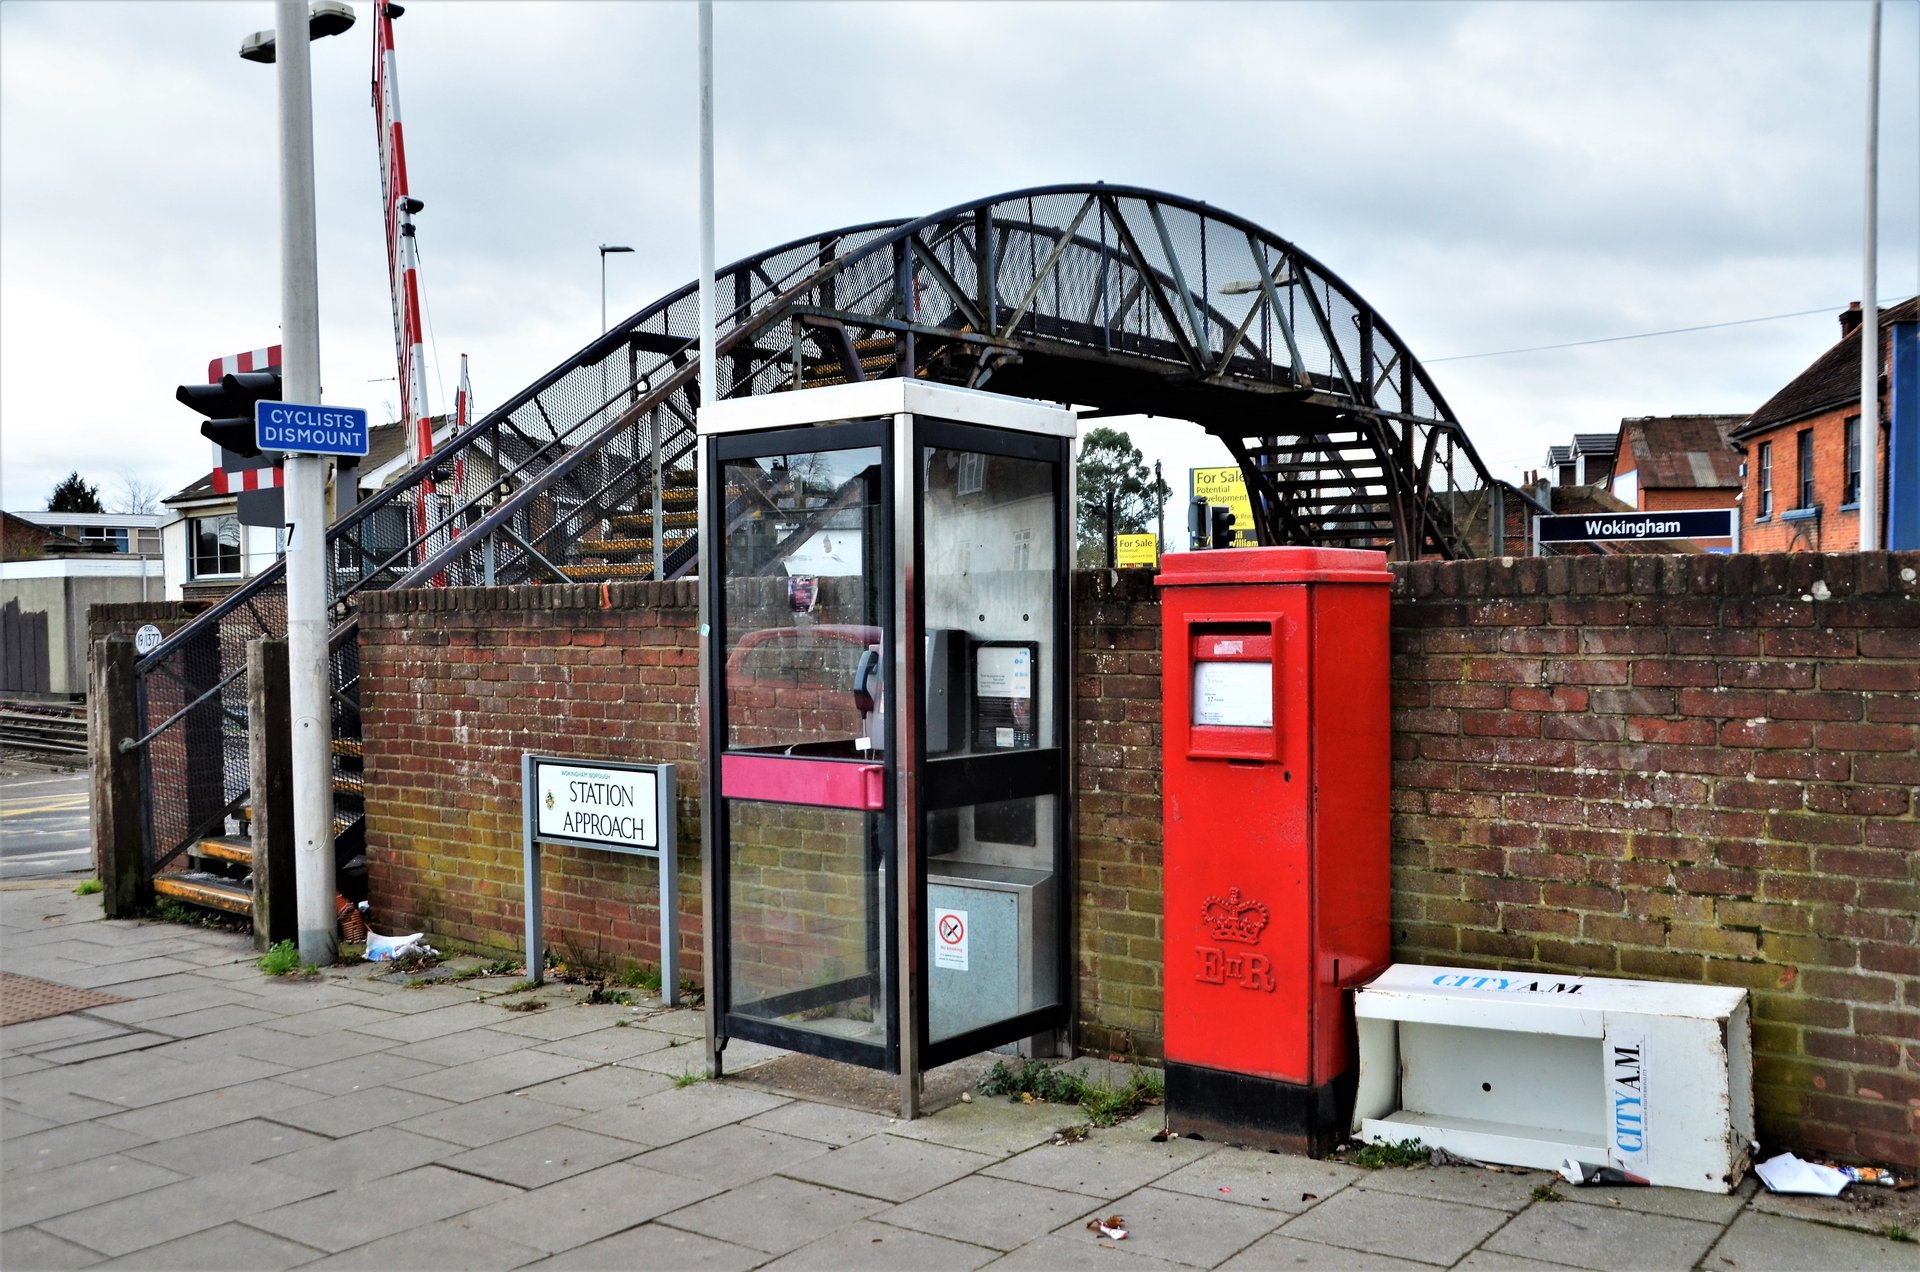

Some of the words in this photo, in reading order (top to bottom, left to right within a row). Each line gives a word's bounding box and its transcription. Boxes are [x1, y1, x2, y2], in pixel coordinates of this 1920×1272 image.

[271, 409, 354, 428] CYCLISTS
[265, 426, 361, 446] DISMOUNT
[1197, 472, 1217, 484] For
[1220, 470, 1244, 483] Sale
[1196, 486, 1230, 494] Potential
[1207, 494, 1248, 504] velopment
[285, 522, 295, 547] 7
[1585, 519, 1681, 537] Wokingham
[1119, 540, 1133, 548] For
[1135, 539, 1153, 547] Sale
[561, 770, 588, 778] WOKINGHAM
[569, 780, 634, 807] STATION
[563, 811, 644, 840] APPROACH
[1433, 974, 1520, 990] CITY
[1614, 1043, 1641, 1092] A.M.
[1615, 1090, 1643, 1153] CITY
